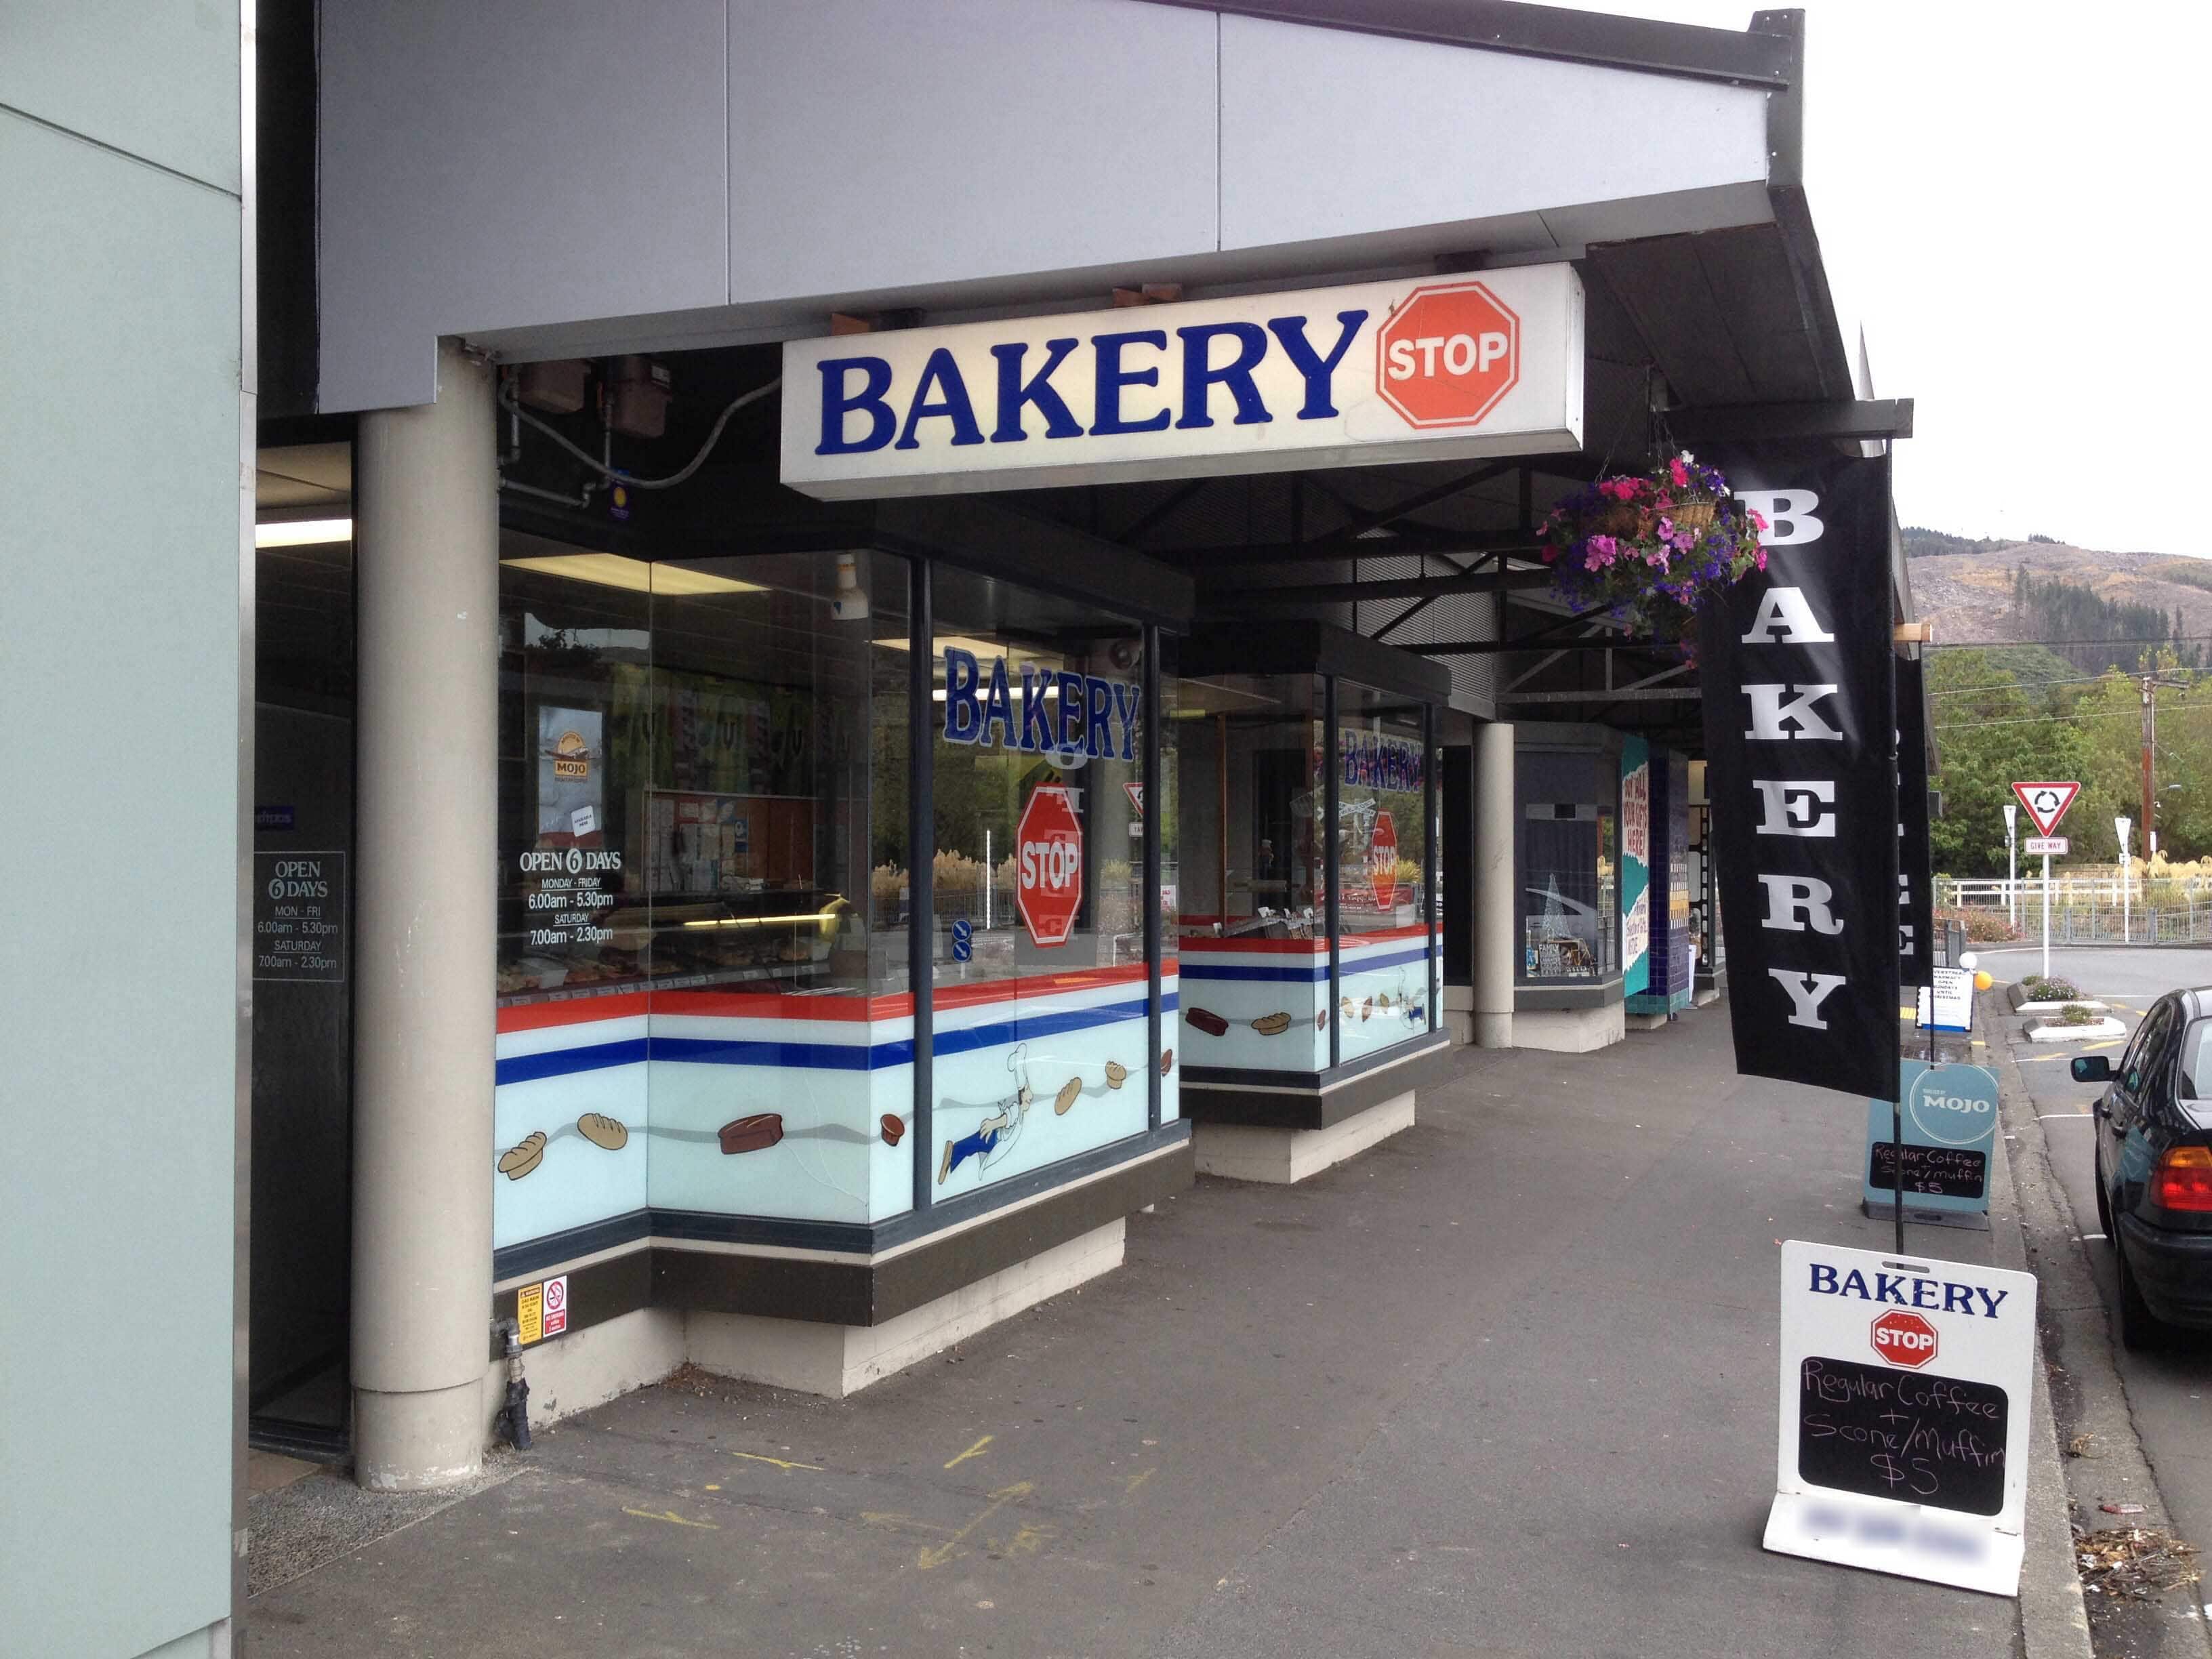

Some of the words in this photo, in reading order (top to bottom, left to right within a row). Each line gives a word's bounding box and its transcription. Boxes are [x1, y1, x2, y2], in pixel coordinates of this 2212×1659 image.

[1387, 330, 1509, 384] STOP
[815, 309, 1369, 456] BAKERY
[943, 644, 1141, 762] BAKERY
[557, 763, 586, 775] MOJO
[1344, 729, 1422, 794] BAKERY
[1734, 489, 1846, 1031] BAKERY
[2030, 842, 2045, 850] GIVE
[275, 861, 321, 878] OPEN
[520, 852, 562, 872] OPEN
[566, 848, 583, 874] 6
[586, 851, 621, 870] DAYS
[1021, 841, 1078, 890] STOP
[1373, 846, 1397, 875] STOP
[268, 878, 285, 899] 6
[287, 881, 328, 897] DAYS
[541, 878, 573, 889] MONDAY
[578, 878, 601, 888] FRIDAY
[529, 893, 567, 909] 6.00am
[577, 891, 613, 909] 5.30pm
[274, 905, 298, 916] MON
[306, 906, 321, 917] FRI
[554, 913, 590, 924] SATURDAY
[258, 921, 293, 933] 6.00am
[530, 929, 567, 945] 7.00am
[577, 926, 613, 944] 2.30pm
[274, 940, 322, 951] SATURDAY
[1923, 1095, 1990, 1113] MOJO
[1927, 1150, 1982, 1167] Coffee
[1914, 1182, 1943, 1193] $5
[1809, 1263, 2008, 1319] BAKERY
[1876, 1326, 1933, 1351] STOP
[1803, 1360, 1894, 1403] Regular
[1898, 1375, 2000, 1418] Coffee
[1870, 1452, 1939, 1494] $5
